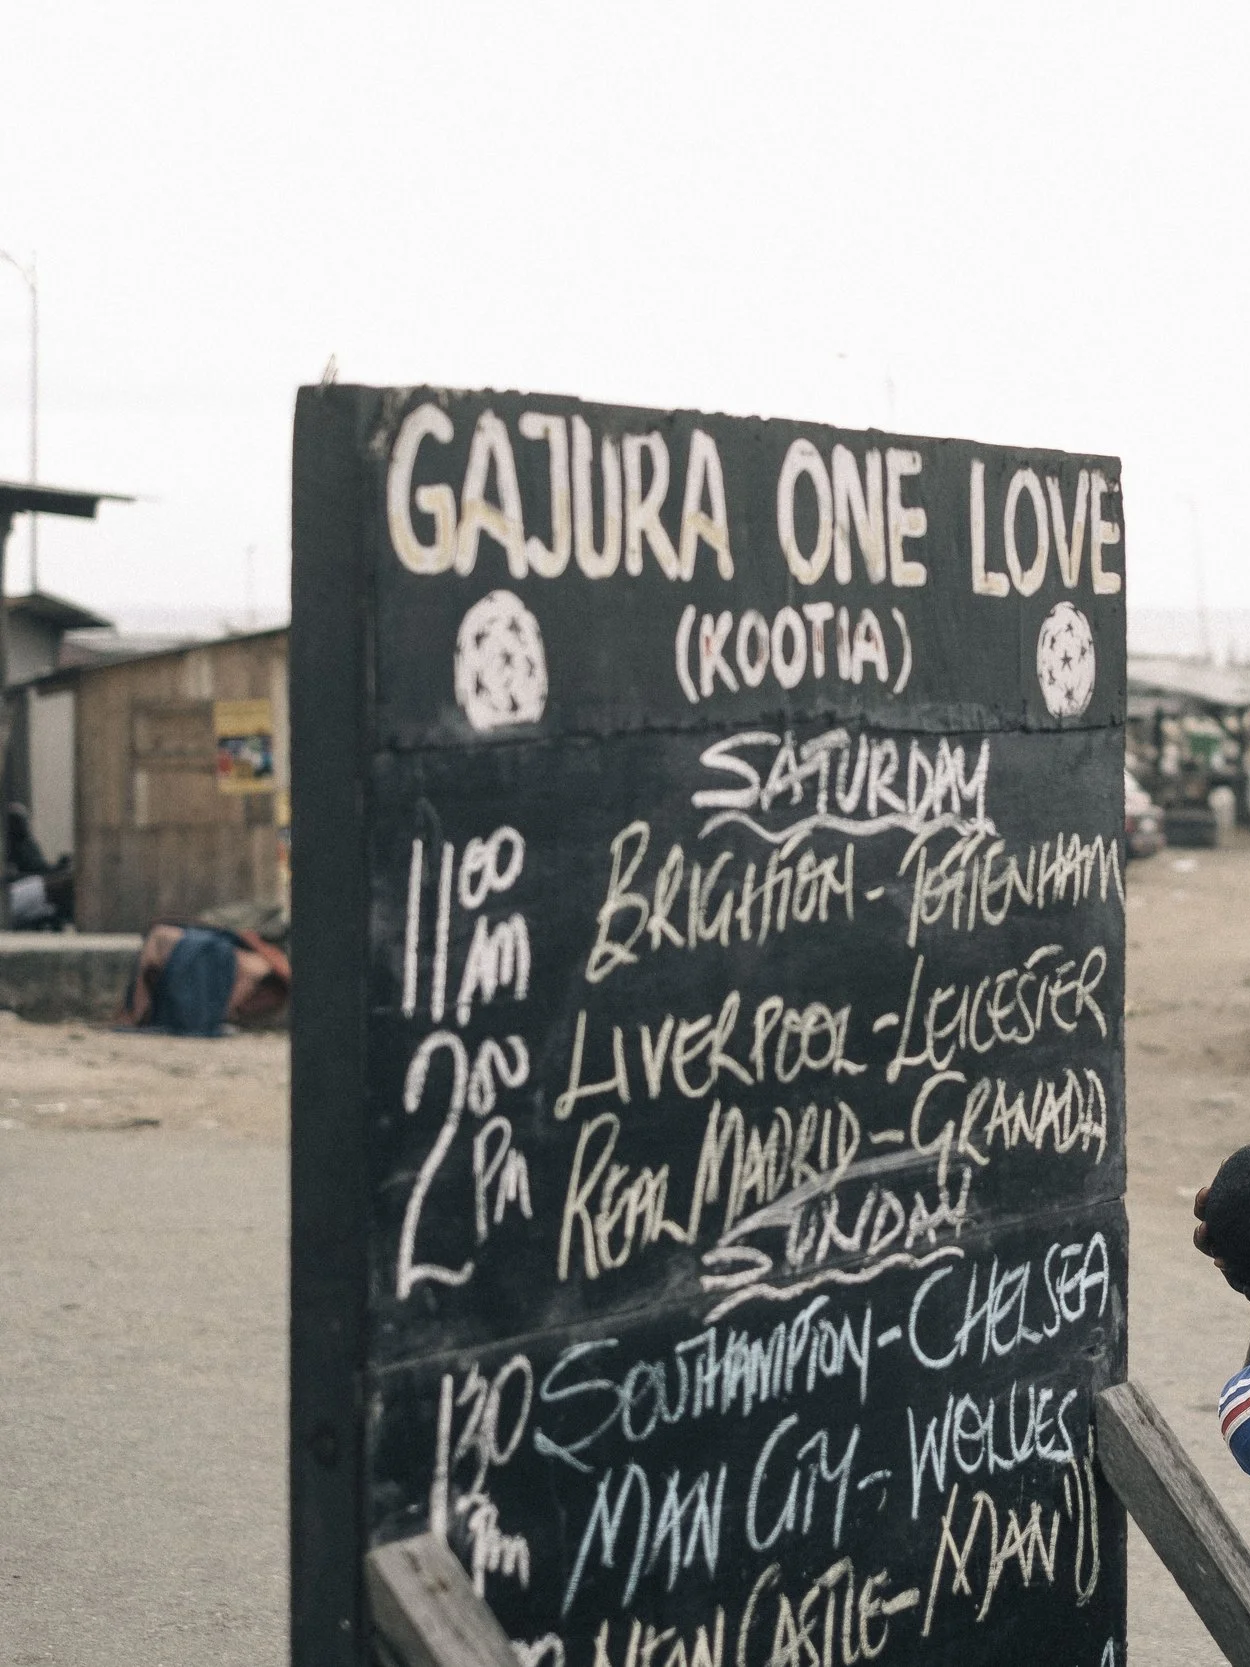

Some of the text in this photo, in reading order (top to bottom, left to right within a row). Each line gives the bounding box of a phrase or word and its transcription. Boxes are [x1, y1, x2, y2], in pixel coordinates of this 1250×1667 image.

[387, 402, 1122, 598] GAJURA ONE LOVE
[691, 728, 990, 828] SATURDAY
[585, 821, 855, 984] BRIGHTON
[898, 814, 1126, 948] TOTTENHAM
[554, 990, 867, 1121] LIVERPOOL
[886, 944, 1108, 1084] LEICESTER
[558, 1112, 690, 1281] REAL
[686, 1098, 861, 1245] MADRID
[911, 1070, 1108, 1187] GRANADA
[702, 1150, 975, 1291] SUNDAY
[909, 1232, 1110, 1370] CHELSEA
[560, 1458, 728, 1620] MAN
[746, 1412, 861, 1551] CITY
[921, 1482, 1061, 1636] MAN
